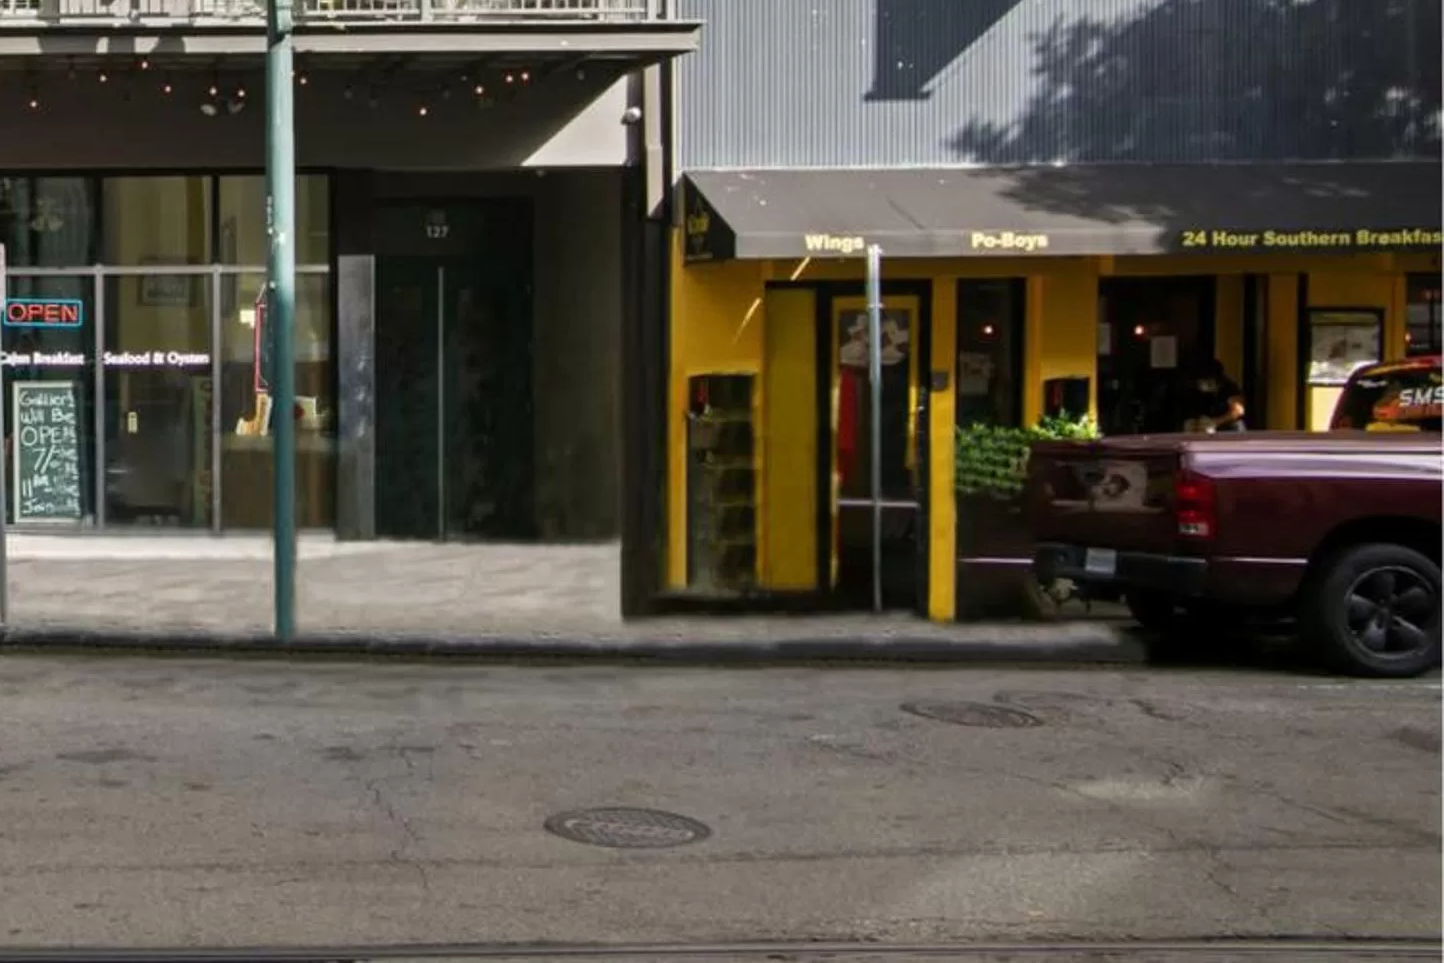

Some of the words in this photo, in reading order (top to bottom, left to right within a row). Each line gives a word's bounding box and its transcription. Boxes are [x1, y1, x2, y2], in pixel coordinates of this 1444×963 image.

[805, 233, 865, 253] Wings
[971, 232, 1049, 252] Po-Boys
[1182, 231, 1206, 246] 24
[1212, 231, 1258, 246] Hour
[1263, 230, 1351, 246] Southern
[7, 303, 79, 323] OPEN
[33, 350, 84, 365] Breakfast
[103, 351, 150, 365] Seafood
